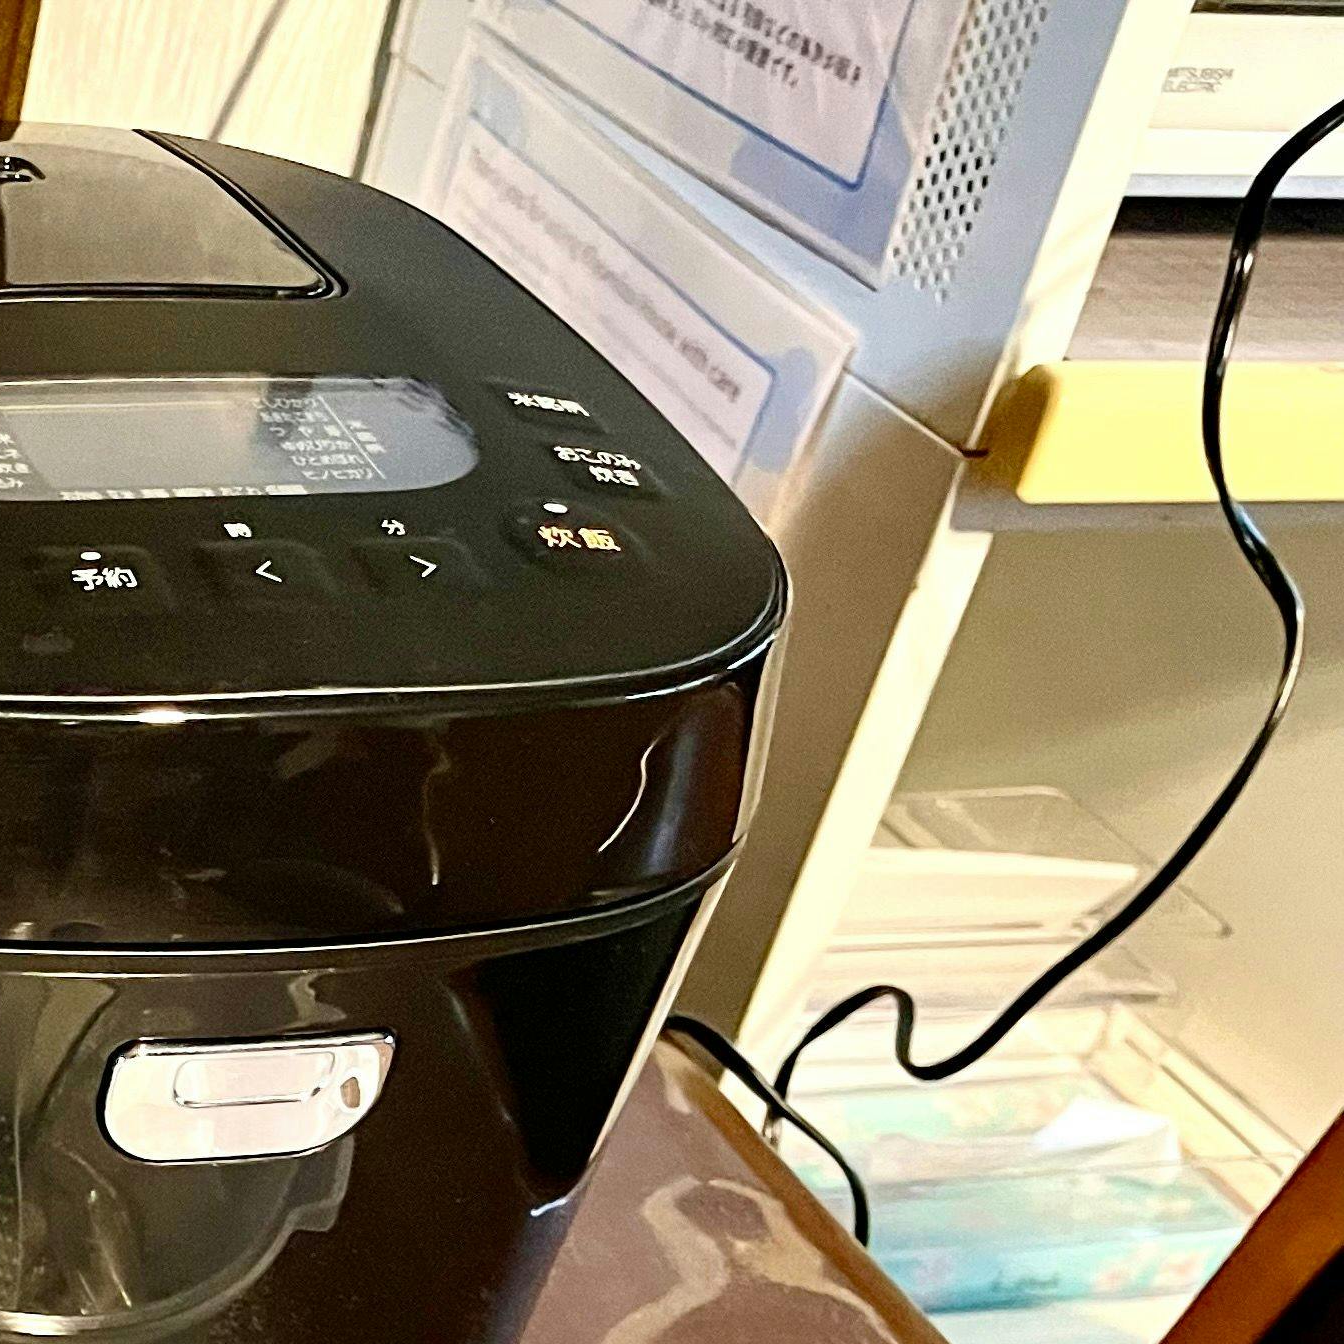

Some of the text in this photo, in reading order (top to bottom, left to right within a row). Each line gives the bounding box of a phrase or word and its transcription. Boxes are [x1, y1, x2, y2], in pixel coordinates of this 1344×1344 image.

[553, 444, 642, 471] おこのみ
[538, 526, 621, 552] 炊飯
[71, 567, 138, 590] 予約
